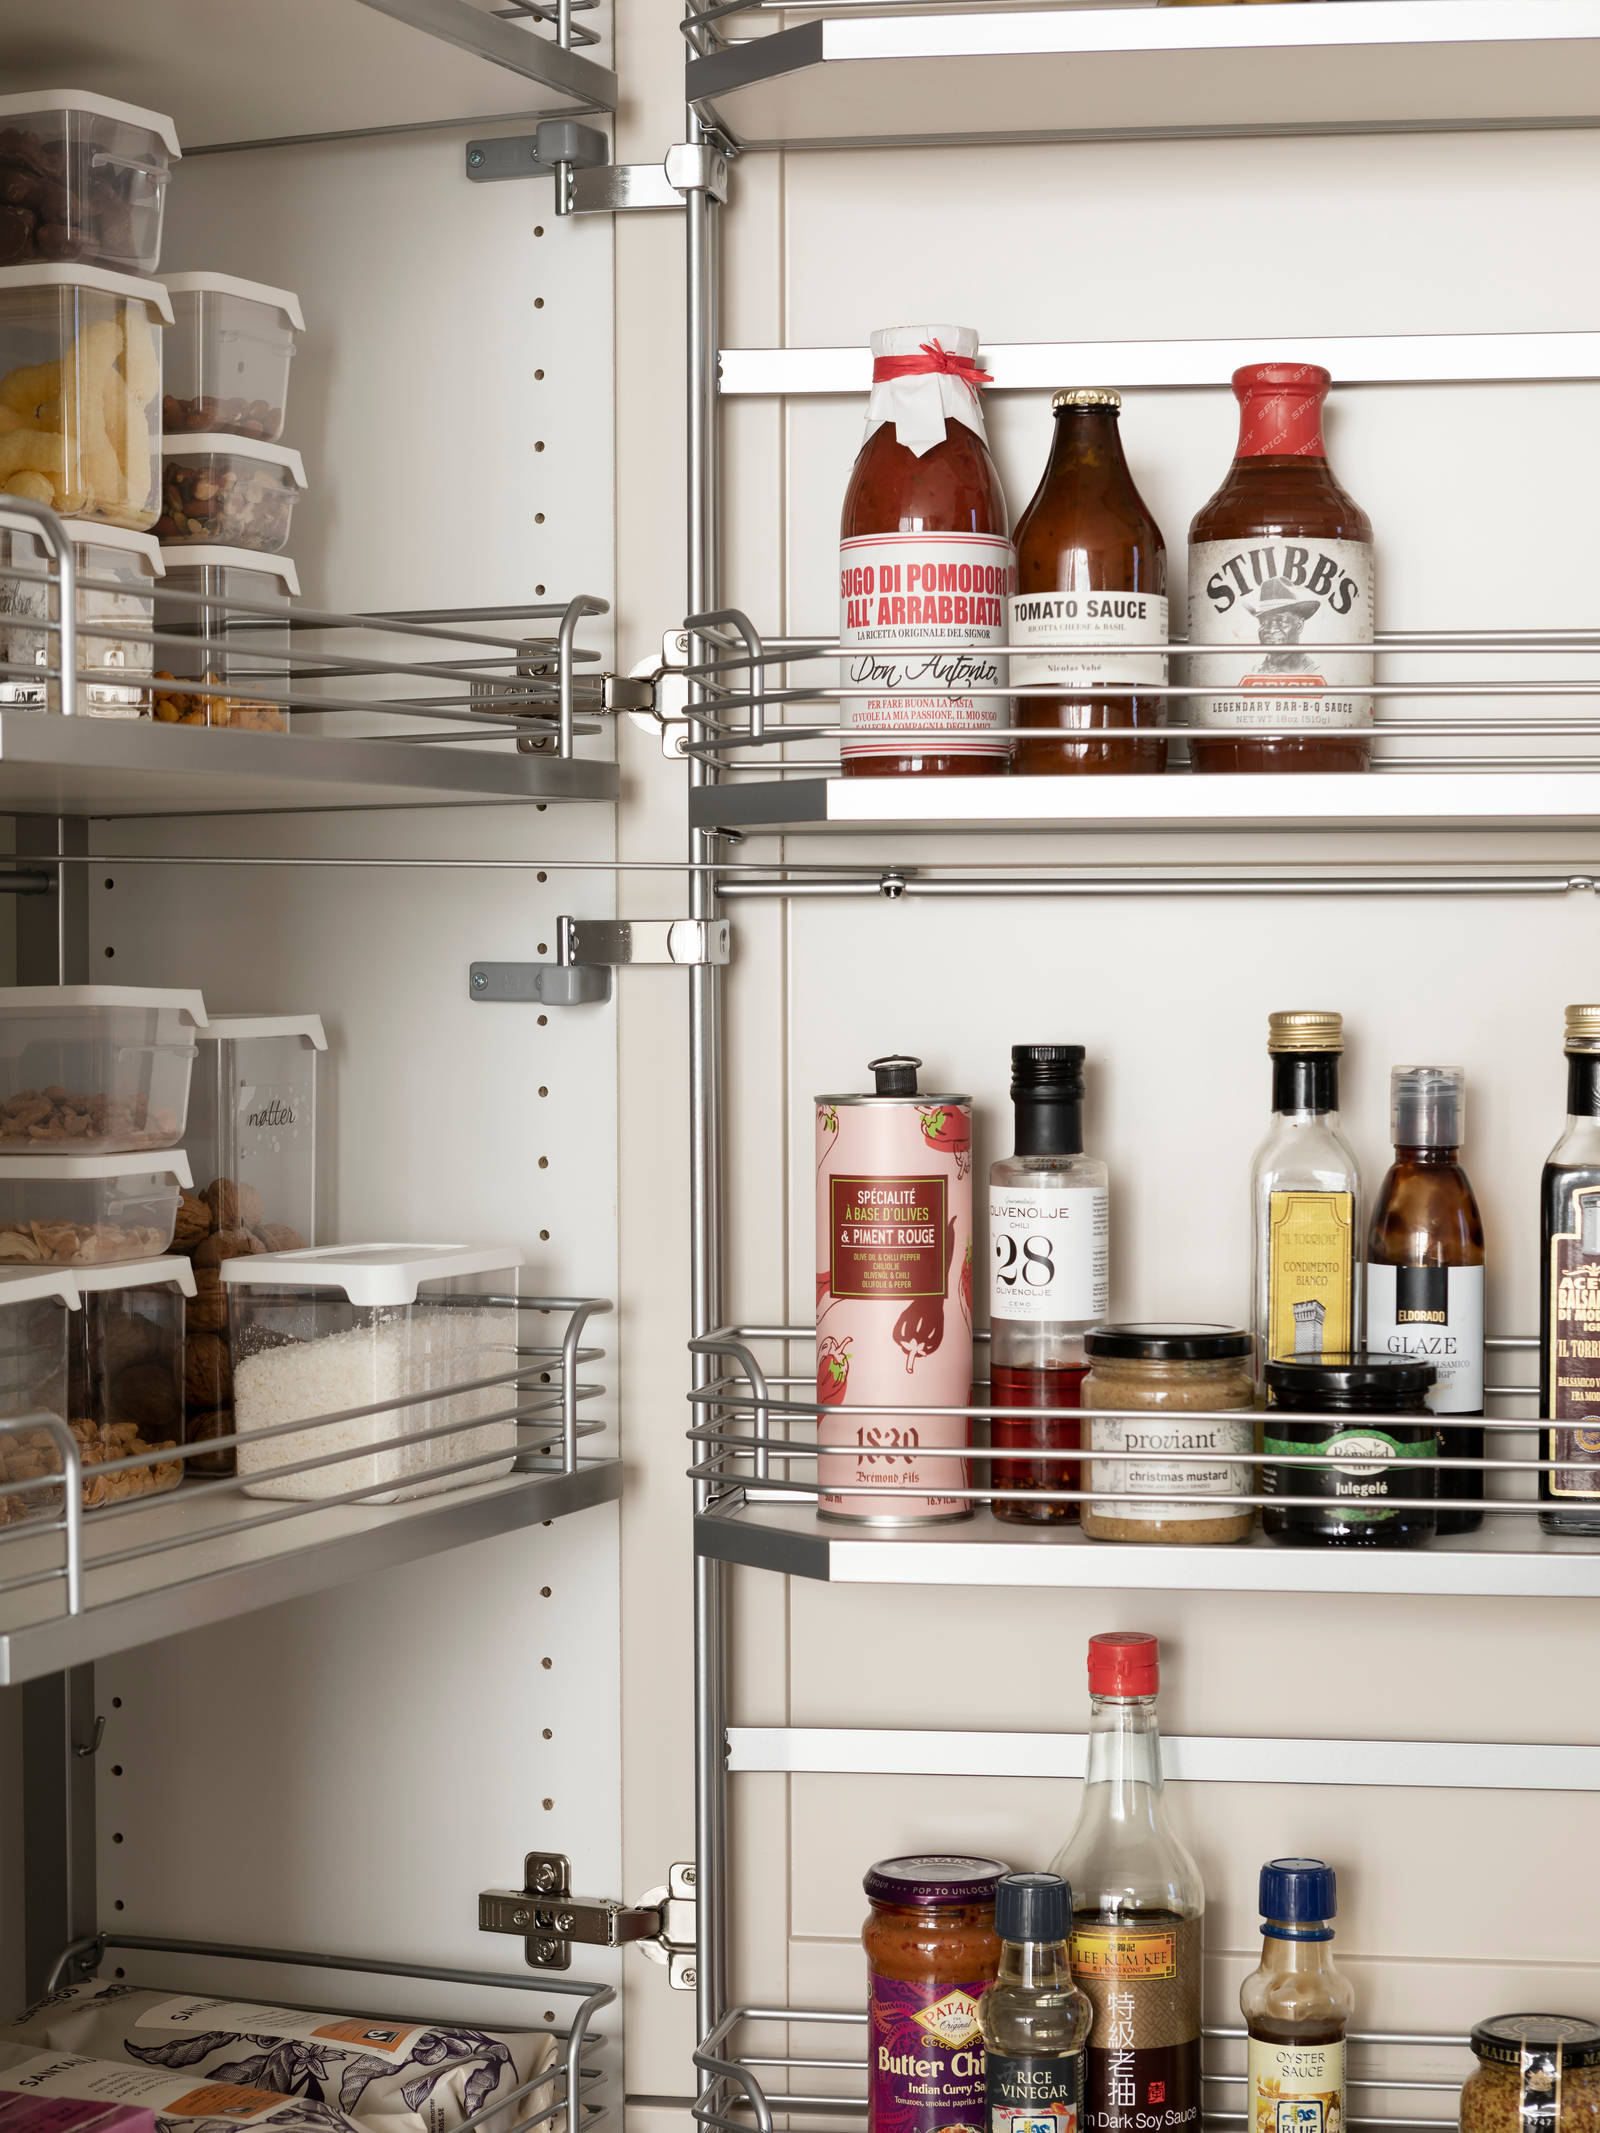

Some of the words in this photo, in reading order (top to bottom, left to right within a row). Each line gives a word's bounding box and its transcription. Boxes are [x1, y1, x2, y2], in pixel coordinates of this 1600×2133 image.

[1258, 389, 1288, 420] SPICY
[841, 566, 875, 599] SUGO
[880, 565, 900, 593] DI
[907, 563, 1007, 597] POMODORO
[1206, 546, 1359, 614] STUBB'S
[1015, 600, 1078, 622] TOMATO
[1087, 600, 1147, 620] SAUCE
[857, 631, 865, 640] LA
[866, 630, 897, 640] RICETTA
[898, 628, 945, 638] ORIGINALE
[947, 629, 964, 638] DEL
[964, 629, 991, 639] SIGNOR
[851, 654, 902, 688] Don
[905, 648, 998, 695] Antonio
[867, 700, 880, 709] PER
[882, 699, 902, 709] FARE
[904, 699, 934, 708] BUONA
[937, 699, 947, 708] LA
[949, 699, 974, 708] PASTA
[1213, 701, 1271, 713] LEGENDARY
[1325, 702, 1353, 713] SAUCE
[881, 711, 891, 721] LA
[893, 711, 909, 720] MIA
[911, 710, 955, 721] PASSIONE,
[966, 711, 980, 720] MIO
[857, 1187, 916, 1205] SPÉCIALITÉ
[854, 1207, 880, 1221] BASE
[883, 1207, 929, 1221] D'OLIVES
[841, 1230, 850, 1243] &
[853, 1229, 893, 1244] PIMENT
[897, 1228, 935, 1244] ROUGE
[900, 1253, 920, 1261] PEPPER
[996, 1234, 1055, 1287] 28
[1283, 1261, 1340, 1273] CONDIMENTO
[1296, 1275, 1328, 1286] BIANCO
[1559, 1277, 1600, 1290] ACE
[1558, 1289, 1600, 1309] BALSA
[1398, 1310, 1446, 1323] ELDORADO
[1387, 1335, 1457, 1355] GLAZE
[1558, 1339, 1569, 1358] IL
[1125, 1429, 1216, 1451] proviant
[1129, 1470, 1184, 1482] christmas
[1186, 1470, 1228, 1482] mustard
[912, 1886, 931, 1894] POP
[936, 1887, 949, 1895] TO
[952, 1886, 988, 1895] UNLOCK
[1077, 1949, 1098, 1965] LEE
[1104, 1953, 1139, 1966] KUM
[1144, 1951, 1168, 1965] KEE
[922, 2001, 977, 2028] PATAK
[940, 2018, 974, 2033] Original
[1108, 1992, 1136, 2107] 特級老抽
[878, 2046, 944, 2078] Butter
[951, 2050, 985, 2077] Chi
[1276, 2051, 1326, 2064] OYSTER
[1017, 2071, 1052, 2085] RICE
[1282, 2065, 1324, 2078] SAUCE
[908, 2082, 940, 2095] Indian
[942, 2083, 972, 2096] Curry
[1001, 2083, 1068, 2100] VINEGAR
[894, 2095, 924, 2107] Tomatoes,
[925, 2098, 951, 2107] smoked
[952, 2098, 976, 2107] paprika
[1098, 2111, 1133, 2129] Dark
[1136, 2112, 1163, 2131] Soy
[1165, 2106, 1197, 2126] Sauce
